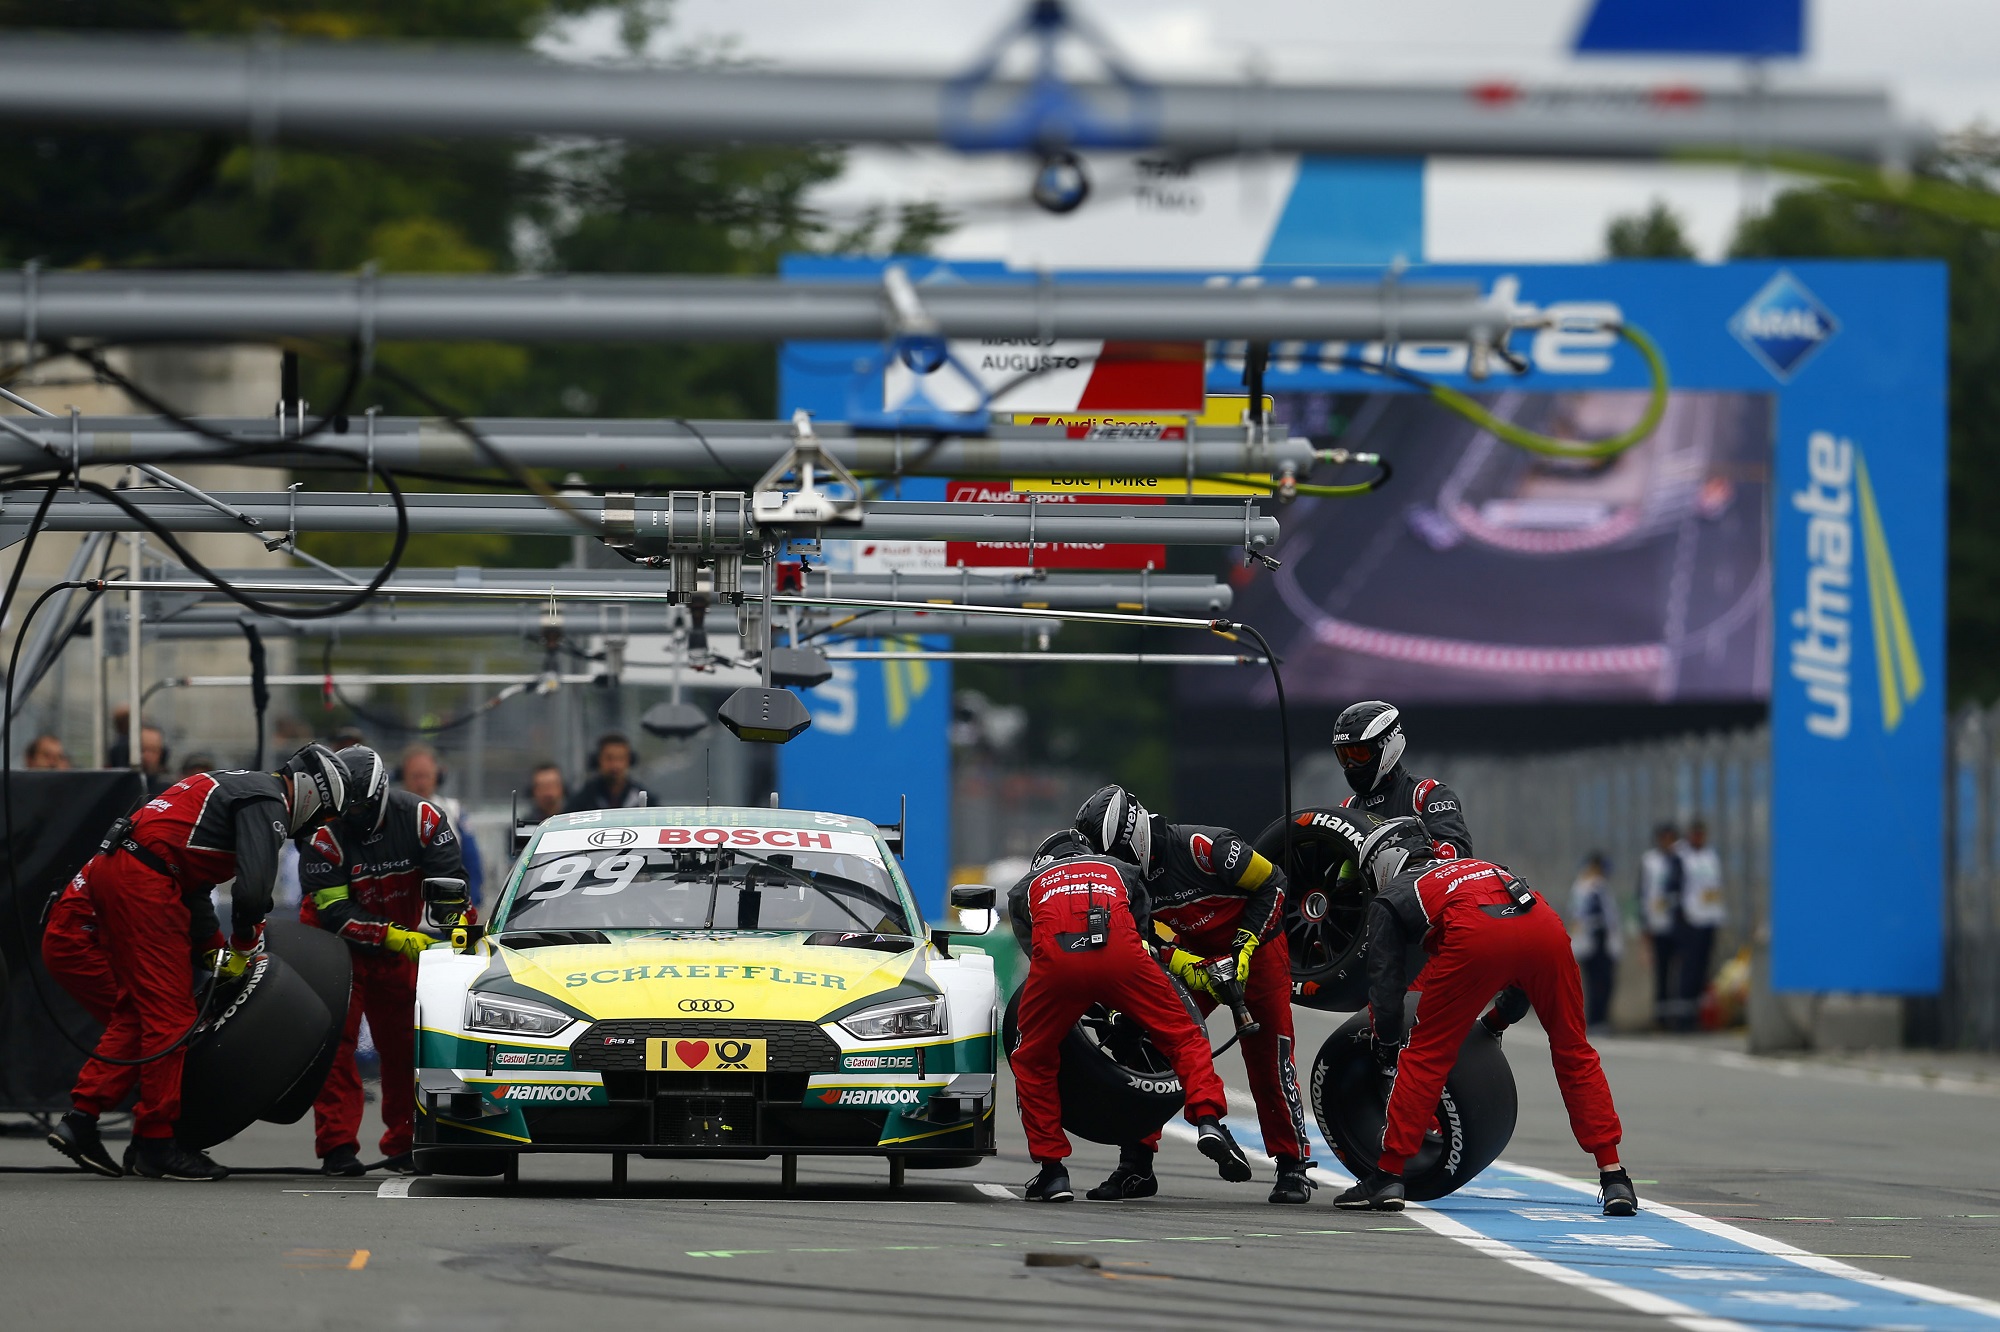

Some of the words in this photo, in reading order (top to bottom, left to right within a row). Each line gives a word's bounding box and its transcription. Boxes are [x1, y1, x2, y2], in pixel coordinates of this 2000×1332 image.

[981, 354, 1080, 372] AUGUSTO
[1791, 431, 1854, 739] ultimate
[313, 771, 332, 809] uvex
[1120, 803, 1137, 845] uvex
[658, 828, 833, 849] BOSCH
[528, 855, 646, 901] 99
[1063, 872, 1108, 880] Service
[565, 964, 847, 990] SCHAEFFLER
[502, 1053, 526, 1065] Castrol
[526, 1053, 567, 1066] EDGE
[661, 1040, 668, 1069] I
[852, 1056, 877, 1068] Castrol
[877, 1056, 914, 1069] EDGE
